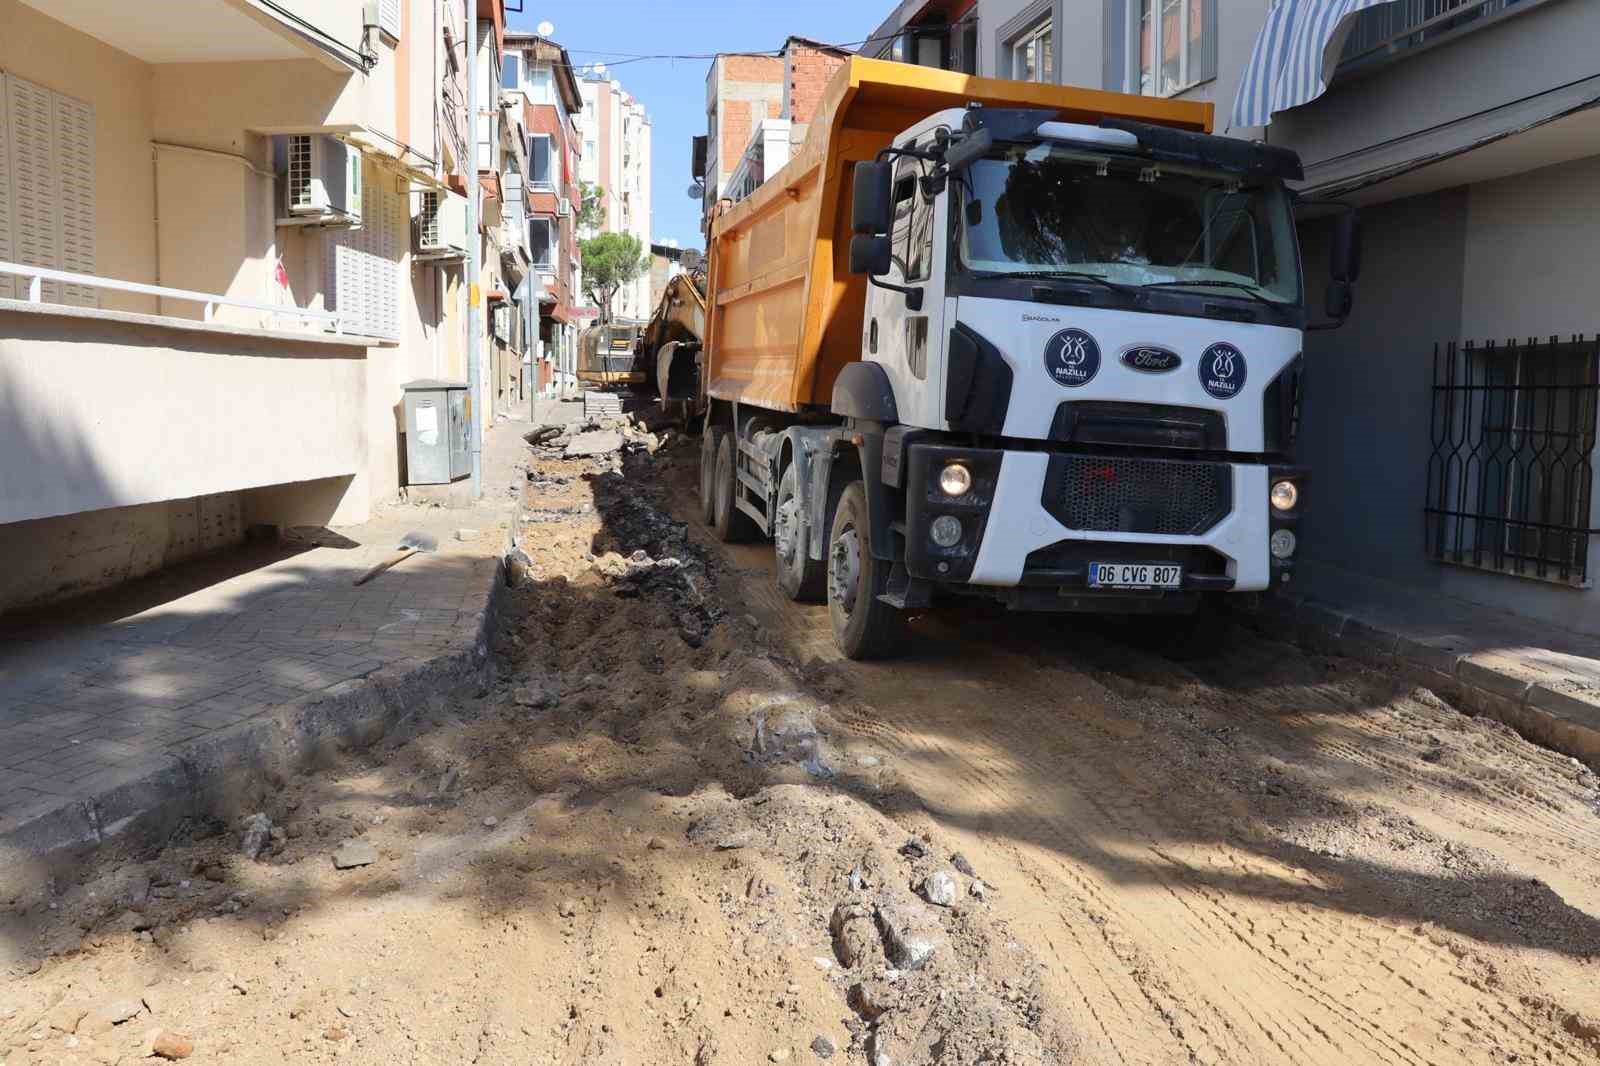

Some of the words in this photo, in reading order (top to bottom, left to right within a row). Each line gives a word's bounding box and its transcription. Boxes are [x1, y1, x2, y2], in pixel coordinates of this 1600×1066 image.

[1135, 350, 1170, 368] Ford
[1098, 566, 1115, 582] 06
[1122, 566, 1147, 583] CVG
[1153, 567, 1178, 583] 807
